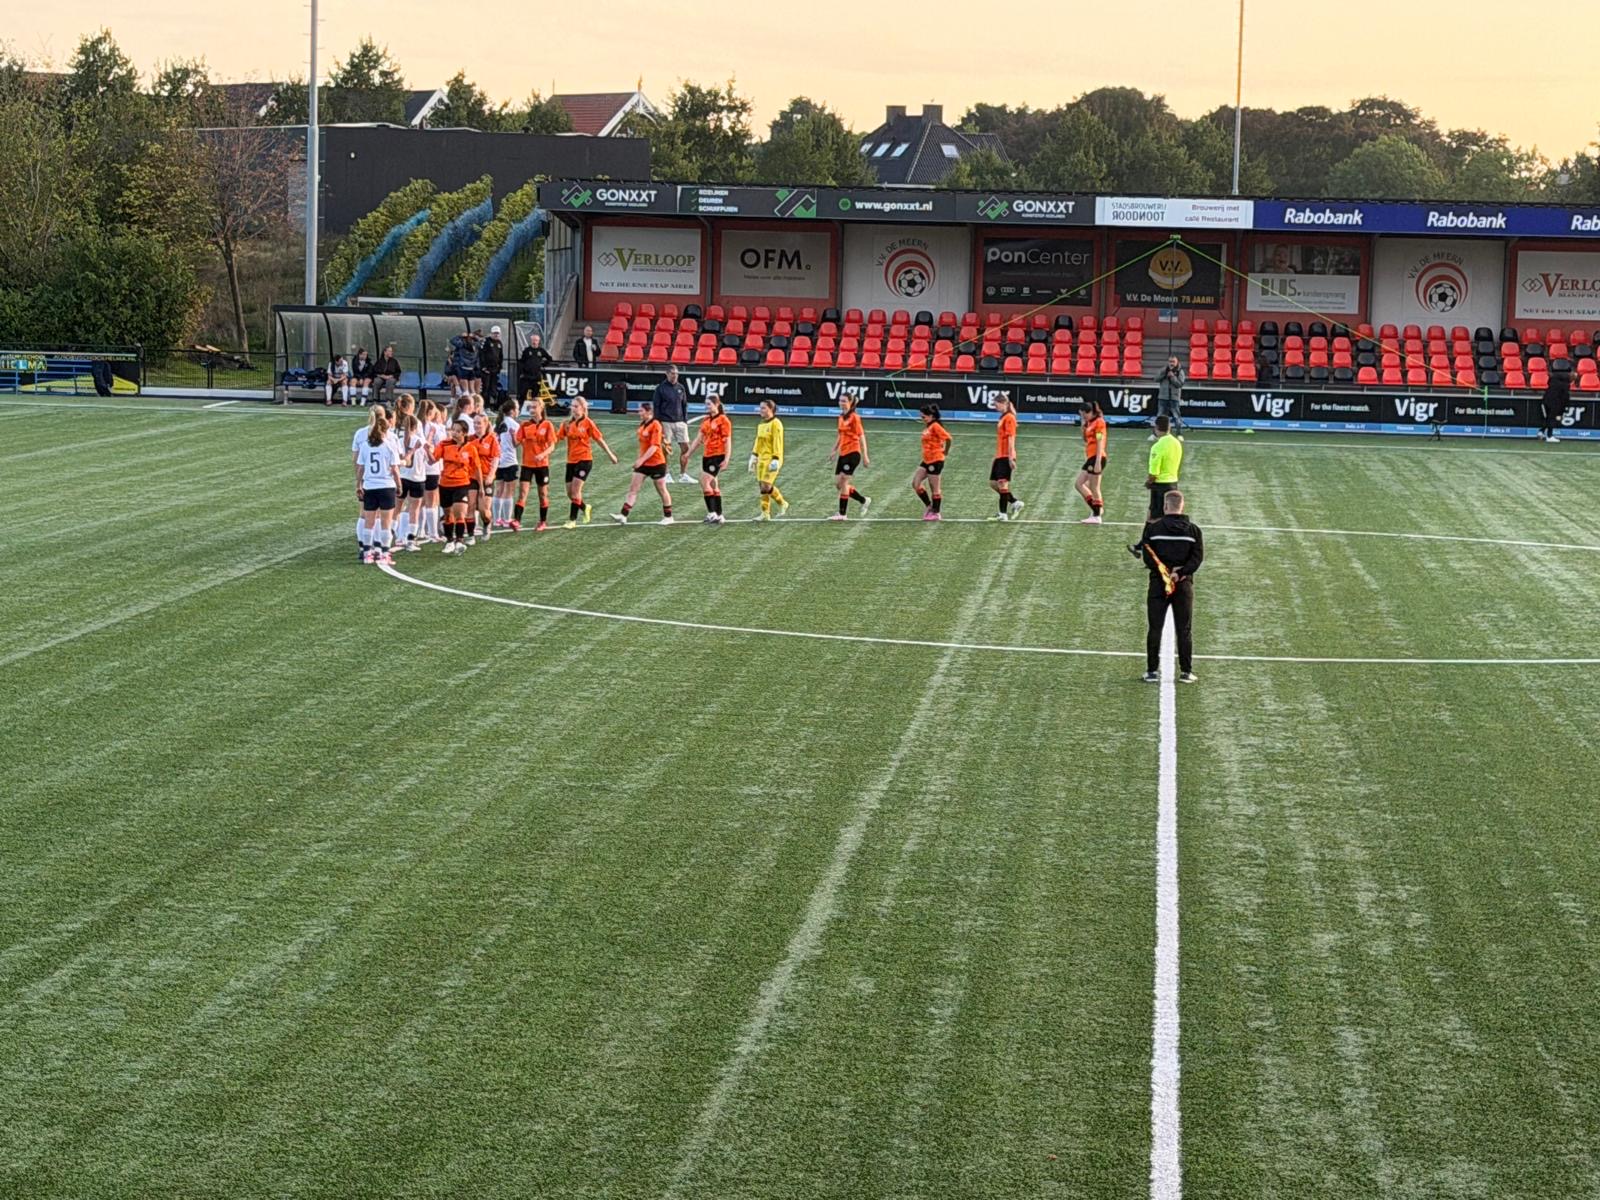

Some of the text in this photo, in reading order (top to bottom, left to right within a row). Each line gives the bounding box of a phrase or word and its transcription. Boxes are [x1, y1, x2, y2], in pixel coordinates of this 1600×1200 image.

[595, 188, 657, 203] GONXXT
[855, 201, 933, 212] www.gonxxt.nl
[1012, 200, 1075, 214] GONXXT
[1284, 208, 1363, 225] Rabobank
[1427, 211, 1507, 229] Rabobank
[613, 247, 696, 272] VERLOOP
[987, 247, 1090, 265] PonCenter
[1159, 260, 1183, 272] V.V.
[1140, 294, 1152, 302] De
[545, 373, 589, 396] Vigr
[745, 386, 755, 395] For
[756, 386, 765, 395] the
[766, 386, 783, 395] finest
[885, 390, 895, 398] For
[906, 391, 923, 399] finest
[1048, 395, 1065, 403] finest
[1108, 389, 1152, 413] Vigr
[1189, 400, 1206, 408] finest
[1251, 393, 1294, 418] Vigr
[1311, 402, 1321, 411] For
[1322, 403, 1331, 411] the
[1333, 403, 1350, 411] finest
[1394, 397, 1438, 422] Vigr
[1455, 407, 1465, 415] For
[1466, 407, 1476, 415] the
[1477, 407, 1494, 415] finest
[370, 452, 381, 474] 5
